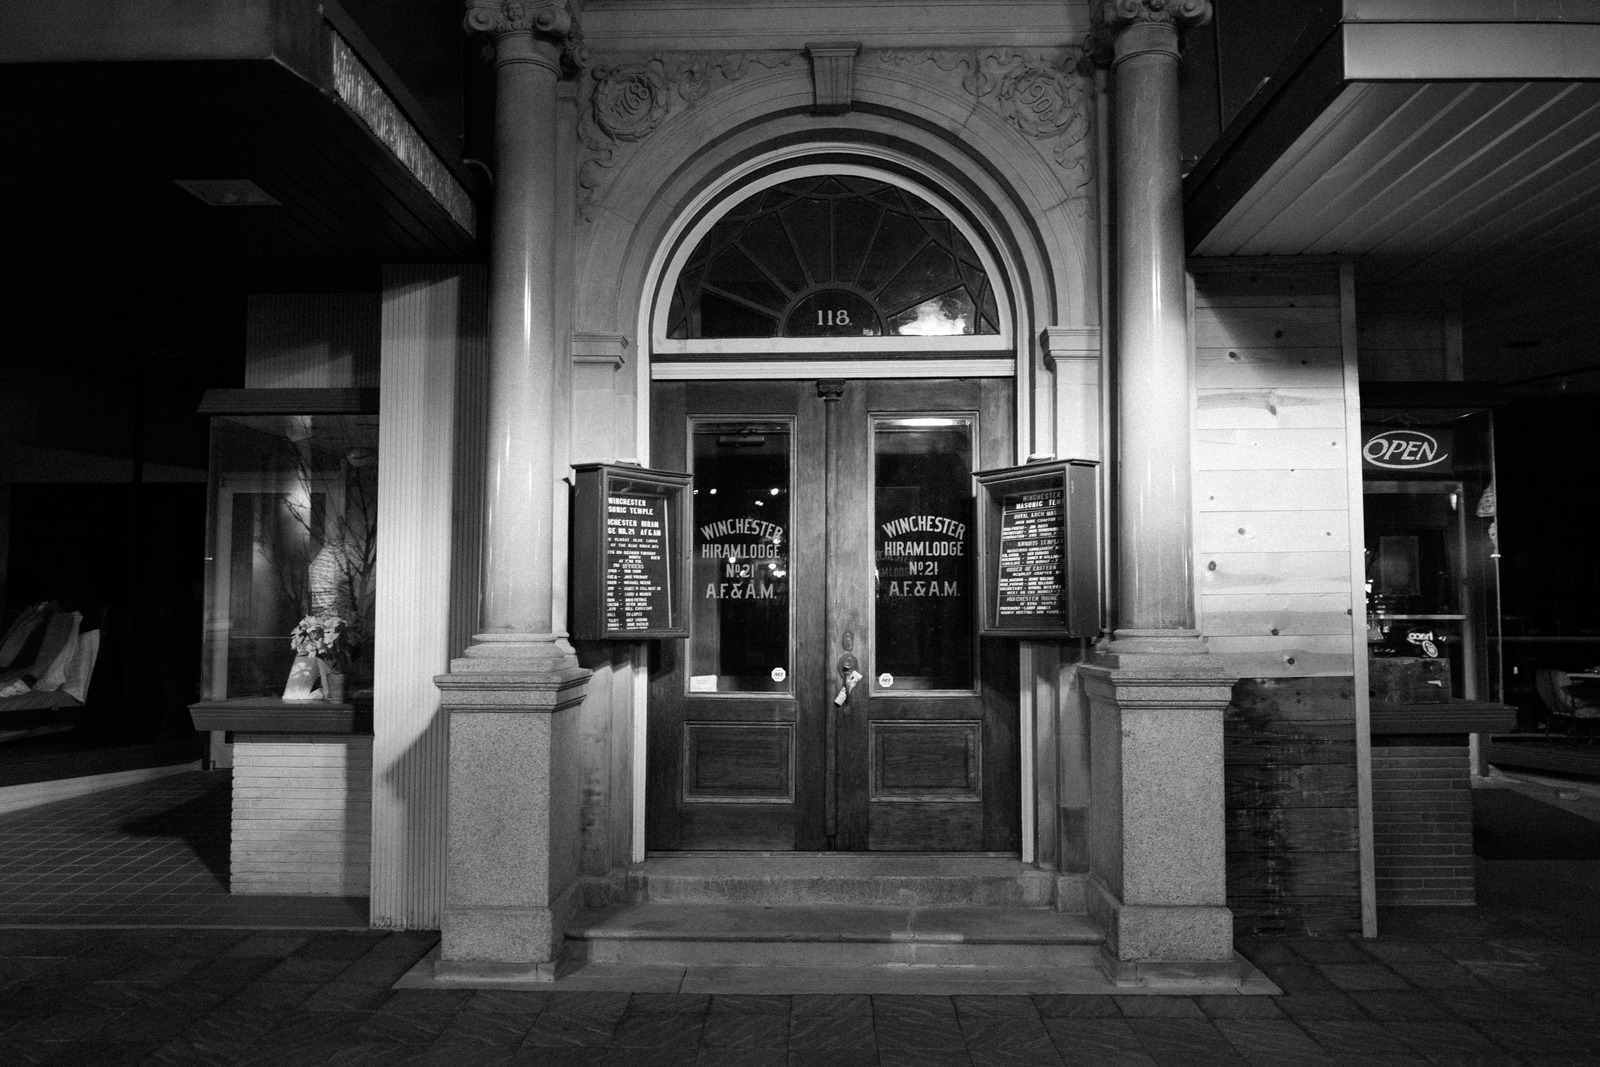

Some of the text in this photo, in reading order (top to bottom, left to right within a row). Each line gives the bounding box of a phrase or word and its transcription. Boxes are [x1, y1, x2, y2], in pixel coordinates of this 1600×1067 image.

[1363, 438, 1437, 461] OPEN
[608, 497, 647, 507] WINCHESTER
[1015, 499, 1044, 510] MASONIC
[629, 507, 654, 516] TEMPLE
[700, 518, 783, 540] WINCHESTER
[882, 515, 966, 540] WINCHESTER
[702, 544, 781, 558] HIRAM LODGE
[885, 541, 924, 556] HIRAM
[926, 541, 964, 556] LODGE
